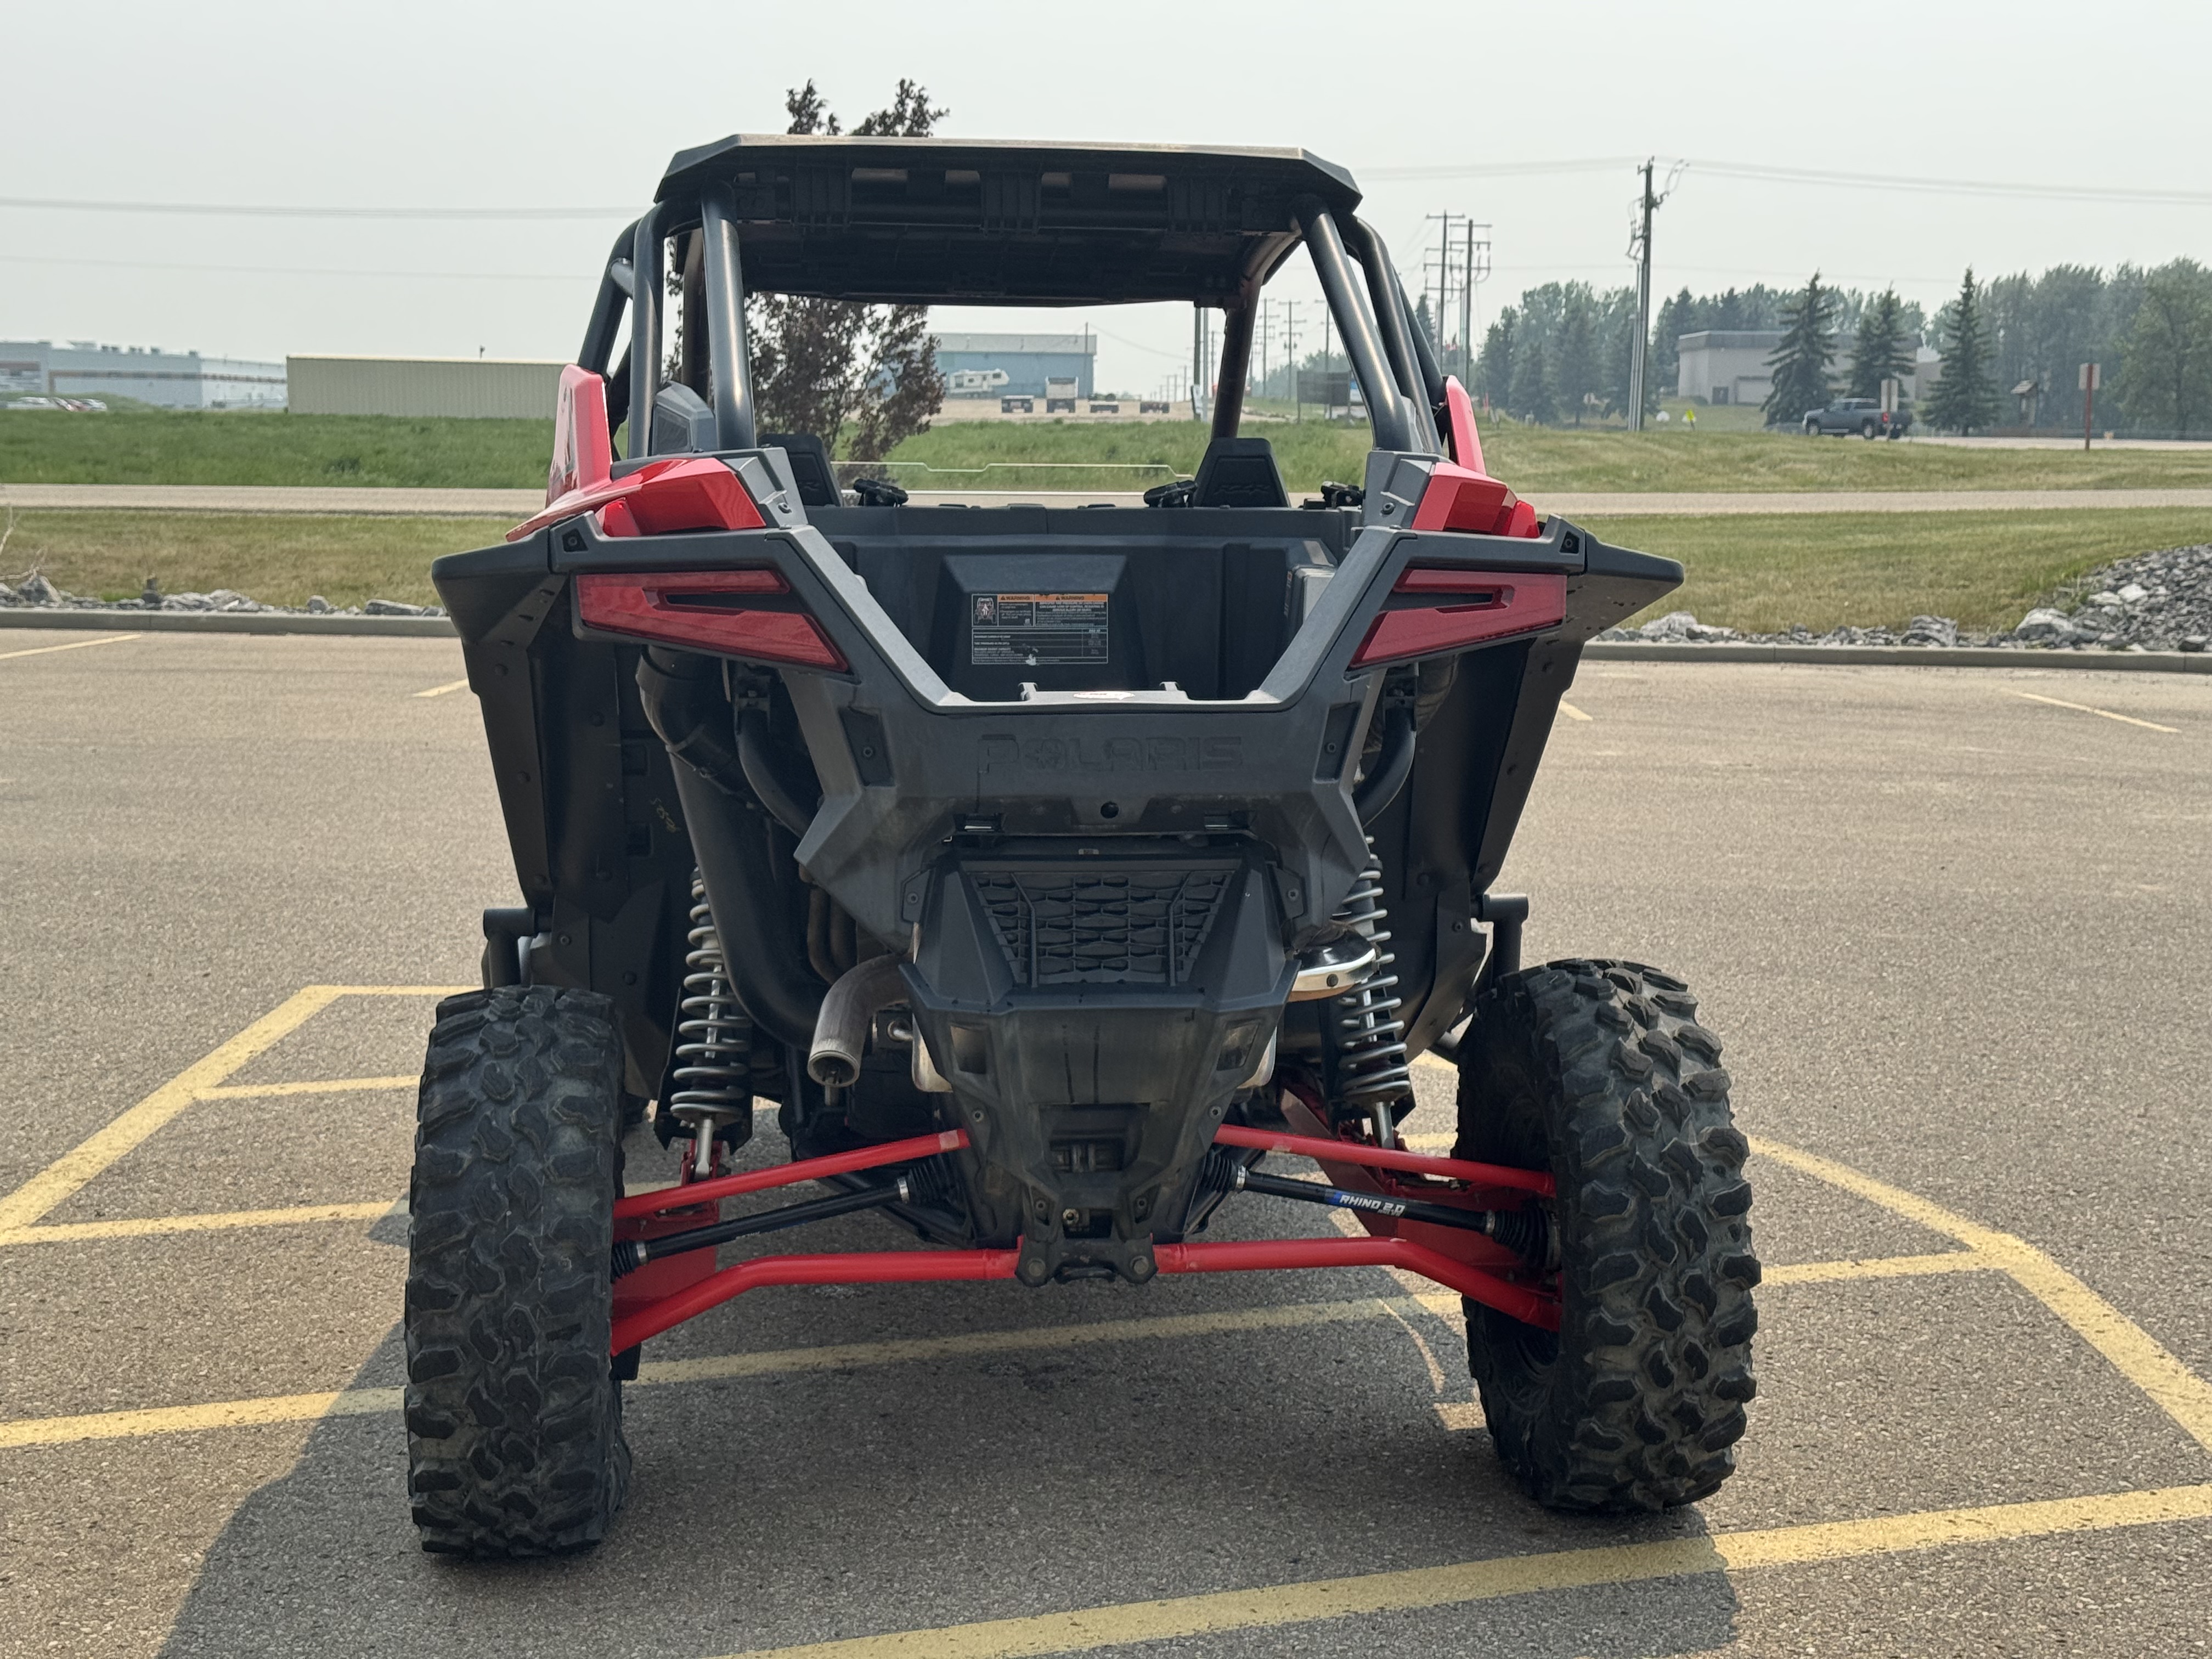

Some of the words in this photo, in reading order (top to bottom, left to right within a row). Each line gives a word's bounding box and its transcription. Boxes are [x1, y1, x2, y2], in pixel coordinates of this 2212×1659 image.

[977, 734, 1243, 772] POLARIS
[1339, 1194, 1382, 1210] RHINO
[1383, 1202, 1406, 1214] 2.0
